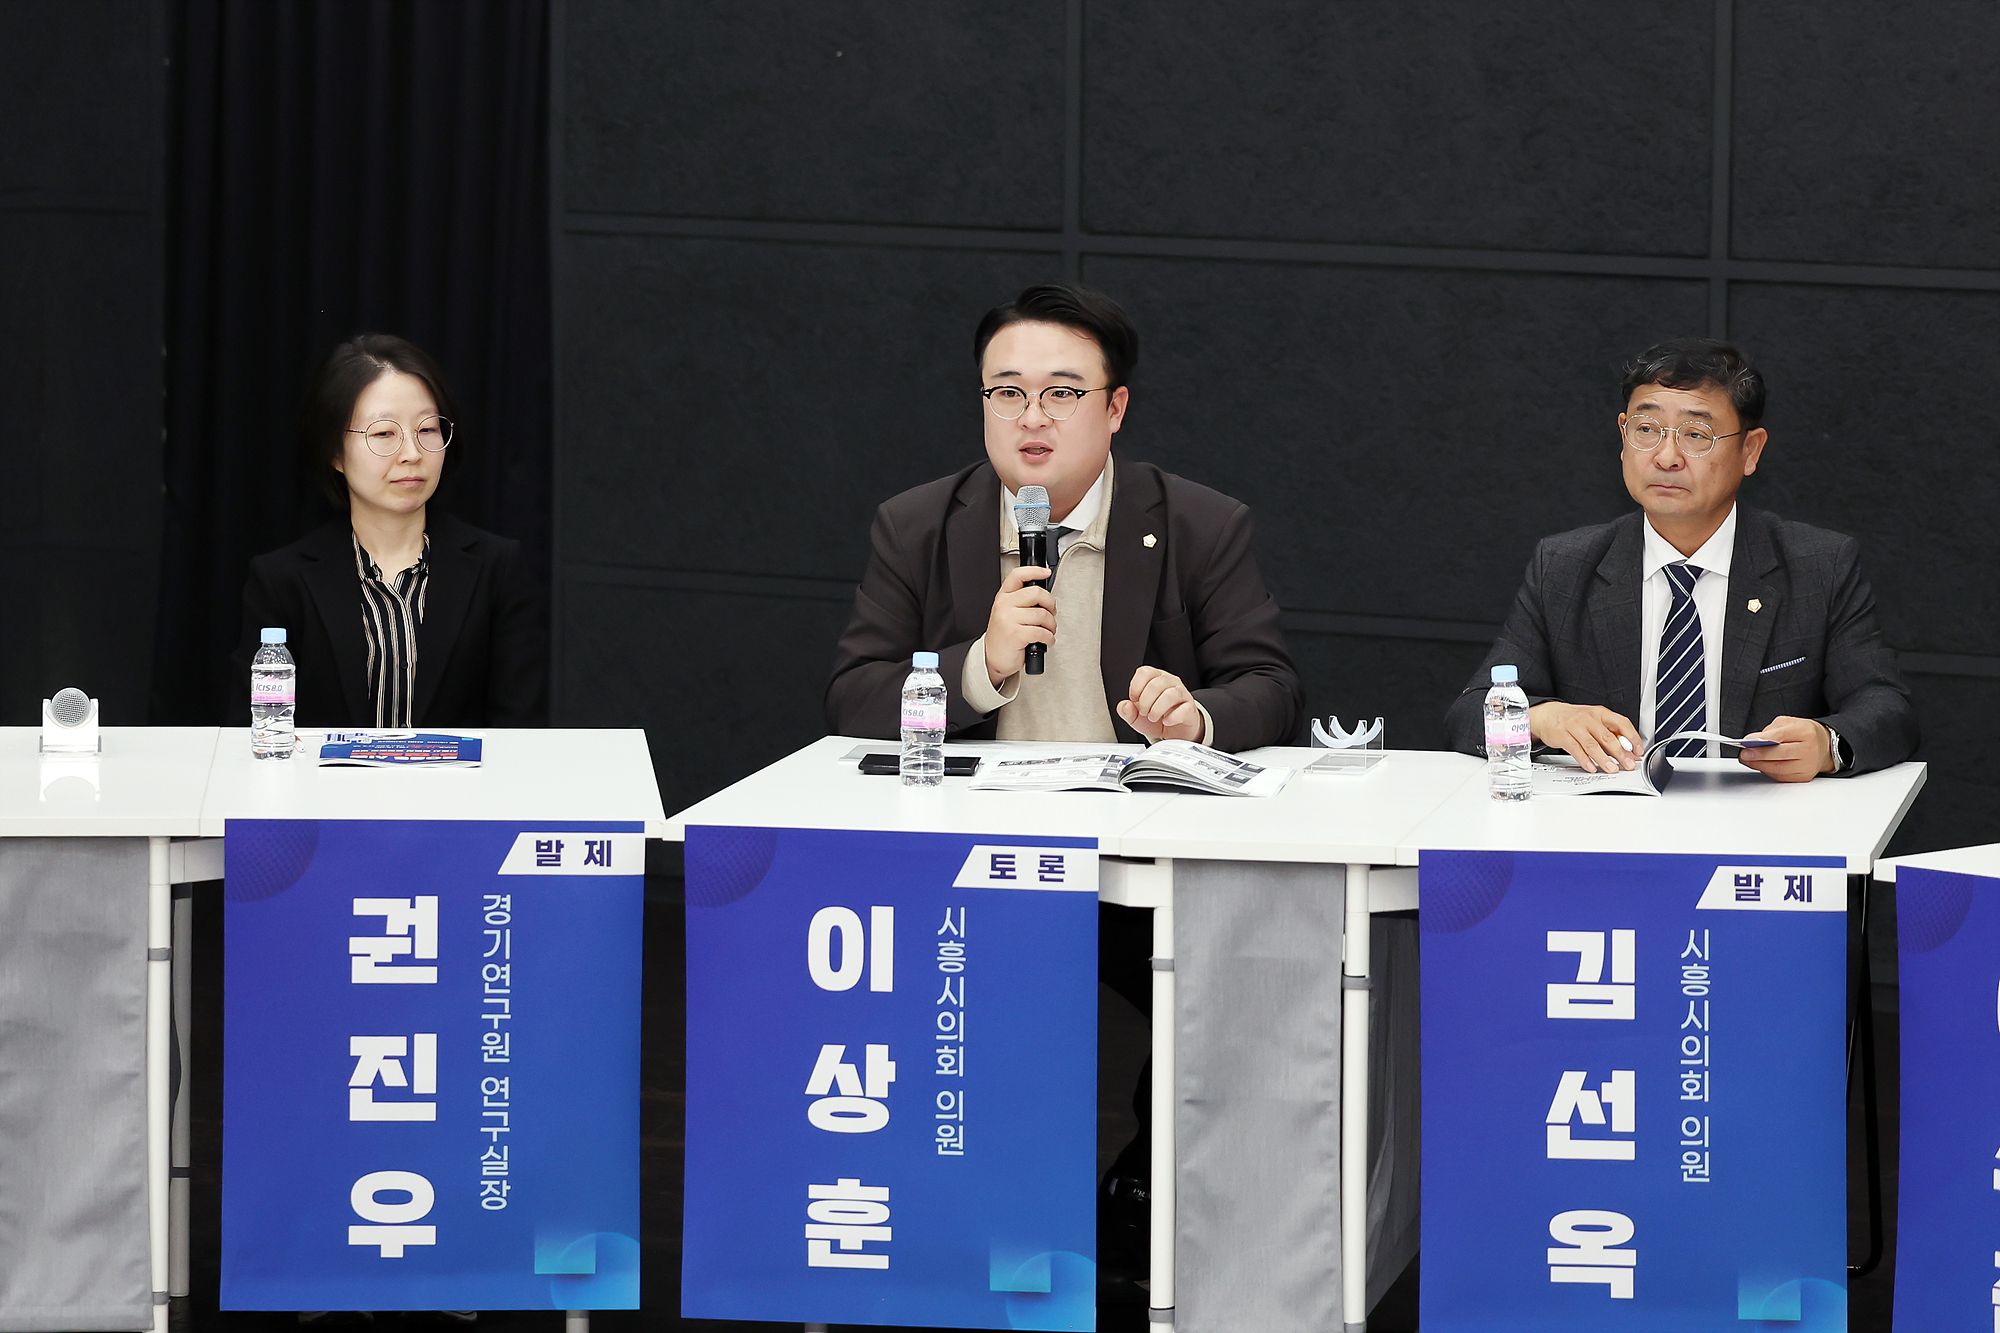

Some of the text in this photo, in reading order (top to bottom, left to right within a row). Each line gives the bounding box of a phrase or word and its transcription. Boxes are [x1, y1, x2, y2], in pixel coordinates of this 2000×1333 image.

[480, 895, 512, 1211] 경기연구원 연구실장
[935, 907, 967, 1156] 시흥시의회 의원
[1680, 928, 1711, 1183] 시흥시의회 의원
